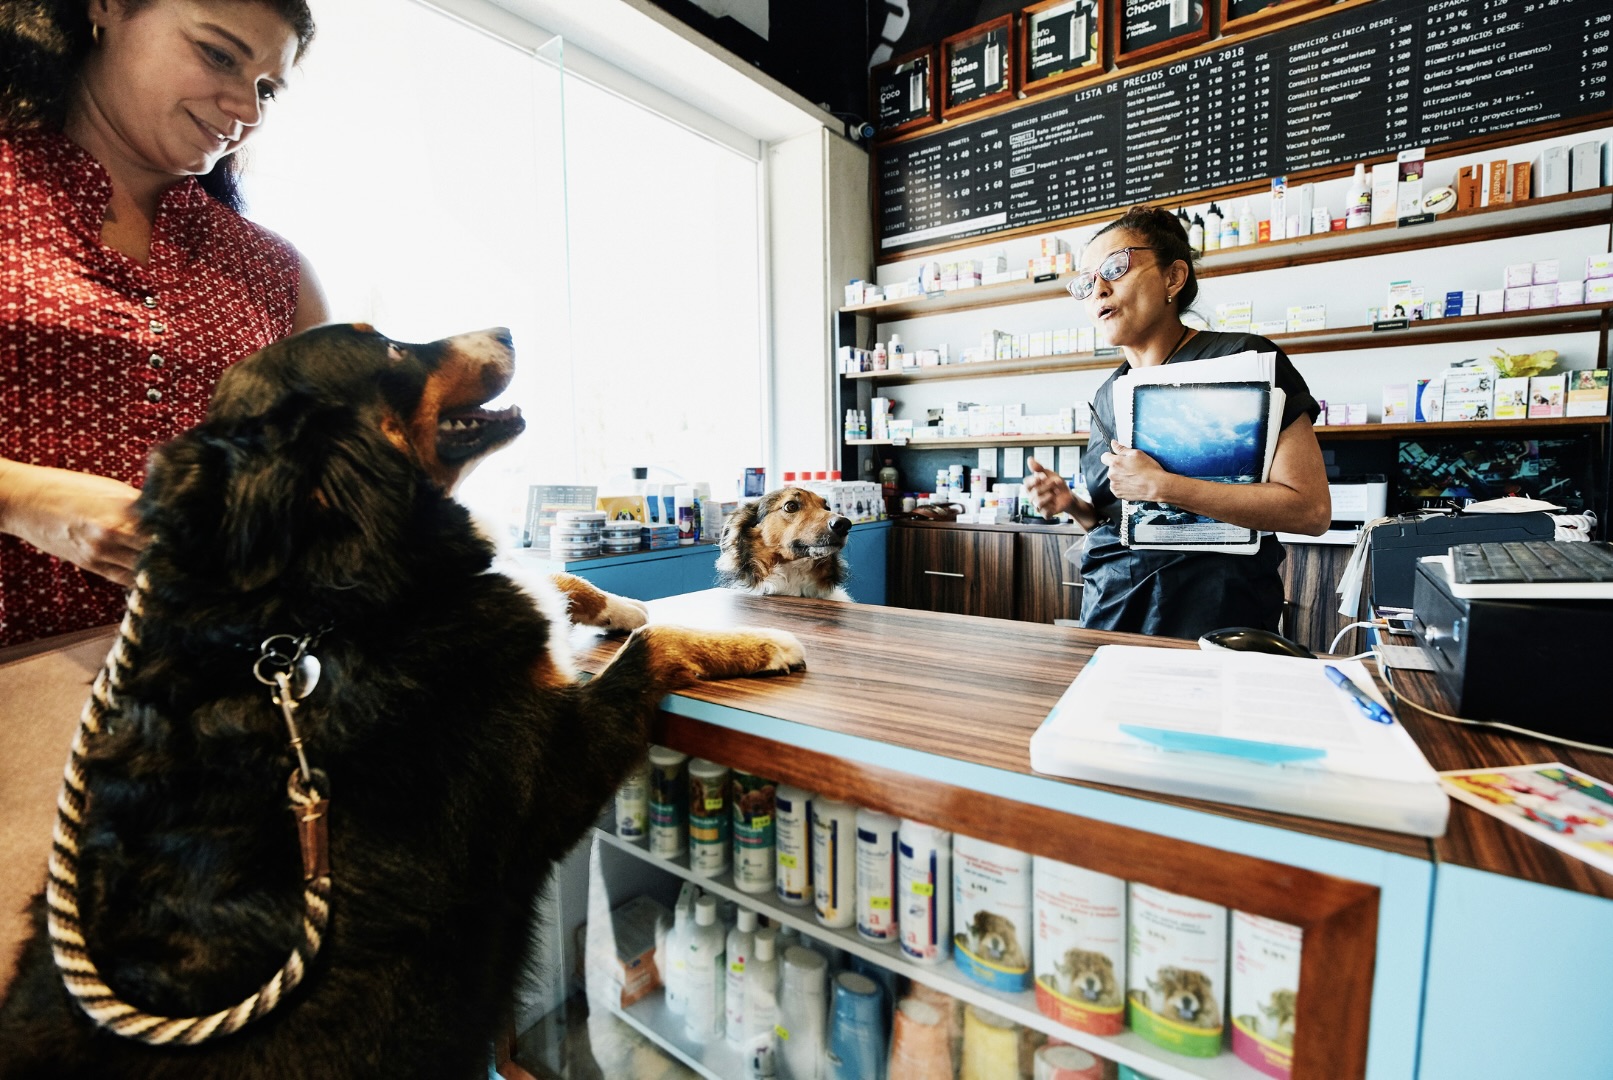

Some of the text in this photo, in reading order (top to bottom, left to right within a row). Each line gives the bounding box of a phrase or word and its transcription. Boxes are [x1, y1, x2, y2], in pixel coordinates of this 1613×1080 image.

[1445, 12, 1455, 20] 10
[1524, 5, 1534, 13] 30
[1427, 31, 1436, 39] 10
[1448, 25, 1458, 34] 20
[1493, 12, 1507, 22] 150
[1595, 14, 1611, 24] 300
[1289, 36, 1328, 52] SERVICIOS
[1369, 17, 1398, 30] DESDE:
[1426, 22, 1524, 52] OTROS SERVICIOS DESDE:
[1032, 35, 1056, 49] Lima
[1497, 30, 1610, 63] (6 Elementos) 650
[1289, 51, 1319, 64] Consulta
[1321, 41, 1349, 55] General
[951, 62, 978, 76] Rosas
[1288, 64, 1318, 76] Consulta
[1332, 48, 1376, 65] Seguimiento
[1075, 47, 1244, 102] LISTA DE PRECIOS CON IVA 2018
[1127, 82, 1166, 97] ADICIONALES
[1255, 53, 1268, 61] GDE
[1288, 76, 1318, 88] Consulta
[1321, 63, 1371, 80] Dermatológica
[1495, 64, 1534, 77] Completa
[1288, 66, 1410, 101] Consulta Especializada 650
[1423, 60, 1607, 107] Ultrasonido 750
[880, 90, 900, 101] Coco
[1422, 76, 1606, 120] Hospitalización 24 550
[1287, 102, 1317, 114] Consulta
[1287, 92, 1408, 126] Vacuna Parvo 350
[1434, 119, 1465, 131] Digital
[1470, 116, 1478, 124] (2
[1482, 102, 1543, 122] proyecciones)
[1589, 90, 1605, 99] 750
[1490, 121, 1515, 132] incluye
[1516, 113, 1561, 126] medicamentos
[1286, 129, 1309, 138] Vacuna
[1312, 123, 1331, 132] Puppy
[992, 141, 1002, 149] 40
[1286, 141, 1308, 150] Vacuna
[1286, 153, 1308, 162] Vacuna
[1393, 132, 1407, 140] 350
[960, 150, 969, 158] 40
[994, 160, 1003, 169] 50
[961, 169, 970, 177] 50
[884, 187, 906, 196] MEDIANO
[994, 180, 1003, 189] 60
[961, 188, 970, 196] 60
[994, 201, 1003, 209] 70
